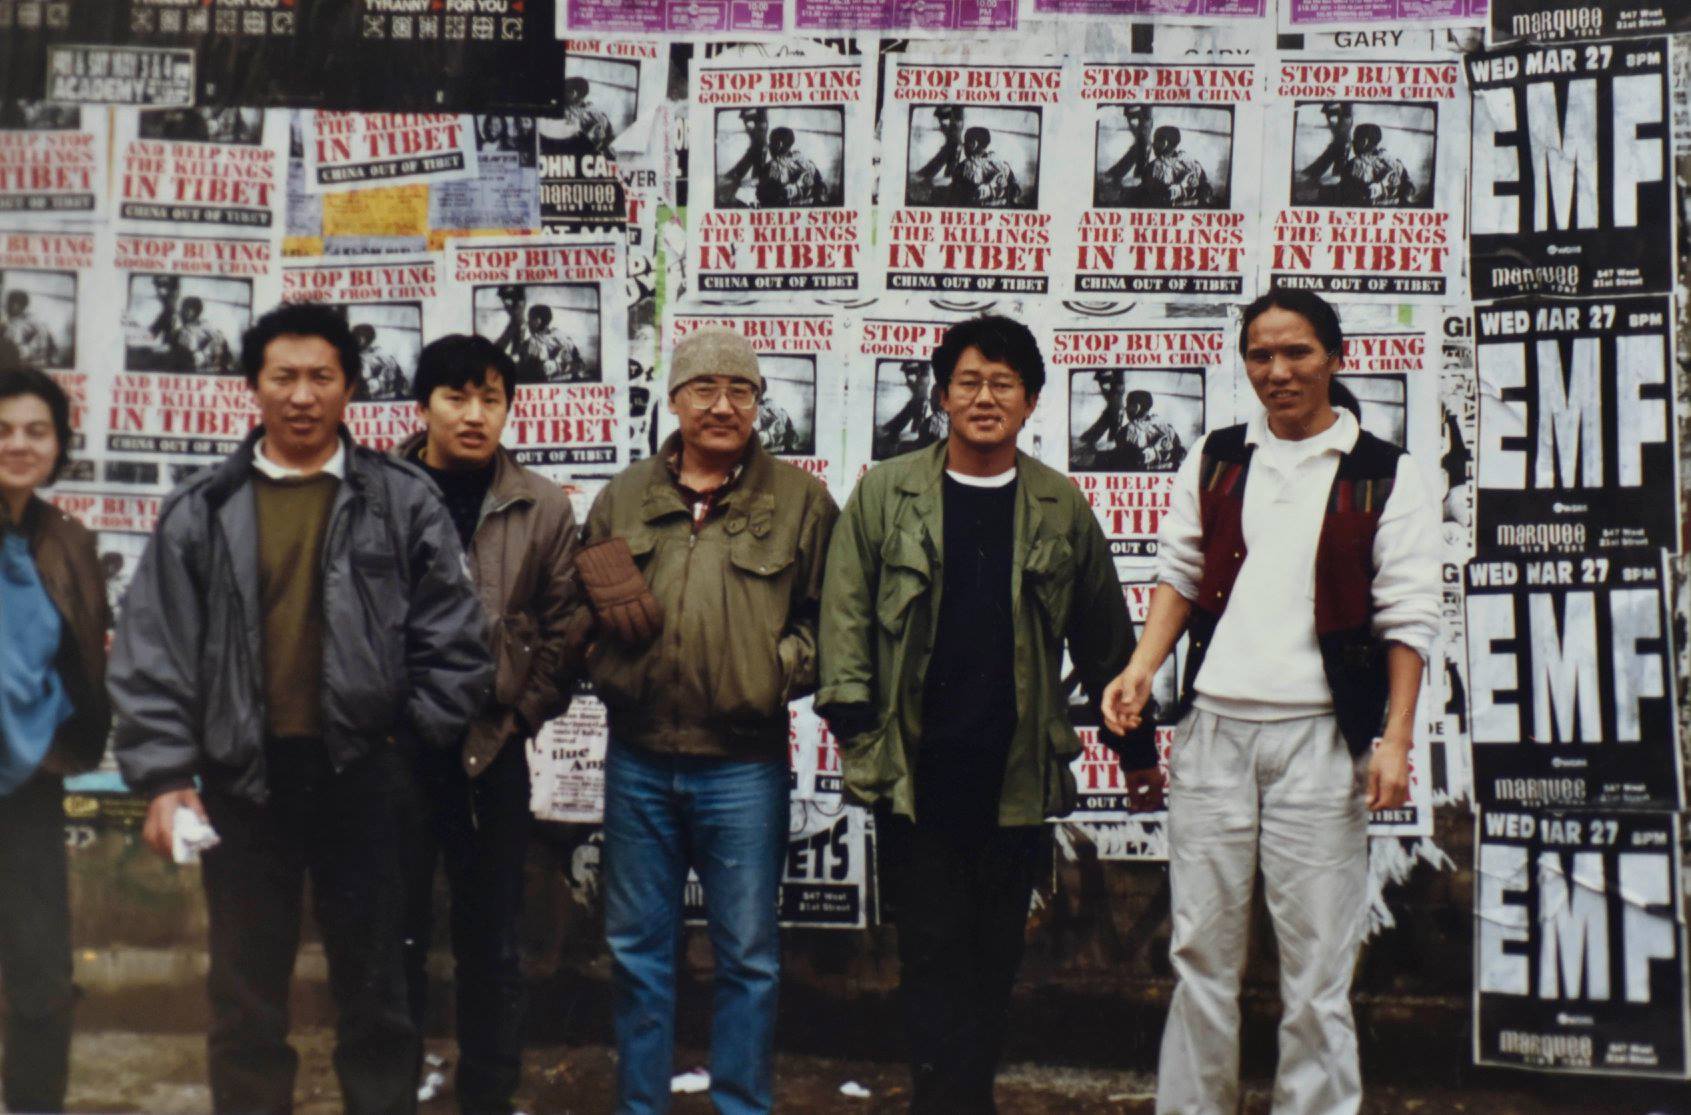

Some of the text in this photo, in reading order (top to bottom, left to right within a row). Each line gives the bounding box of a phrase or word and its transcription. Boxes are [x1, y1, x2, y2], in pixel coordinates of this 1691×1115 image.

[1335, 31, 1402, 48] GARY
[607, 44, 657, 57] CHINA
[1471, 46, 1660, 83] WED MAR 27 8PM
[700, 70, 861, 90] STOP BUYING
[896, 69, 1061, 89] STOP BUYING
[1084, 68, 1253, 87] STOP BUYING
[1281, 66, 1457, 85] STOP BUYING
[699, 89, 860, 103] GOODS FROM CHINA
[894, 88, 1059, 103] GOODS FROM CHINA
[1081, 88, 1251, 101] GOODS FROM CHINA
[1279, 85, 1455, 98] GOODS FROM CHINA
[314, 113, 458, 136] THE KILLINGS
[316, 125, 464, 163] IN TIBET
[1470, 73, 1663, 235] EMF
[126, 157, 165, 172] THE
[322, 168, 364, 181] CHINA
[371, 165, 397, 177] OUT
[402, 162, 417, 174] OF
[123, 175, 275, 206] IN TIBET
[701, 210, 858, 225] AND HELP STOP
[891, 211, 1051, 227] AND HELP STOP
[1079, 212, 1245, 227] AND HELP STOP
[1278, 211, 1320, 225] AND
[1392, 212, 1449, 226] STOP
[699, 227, 858, 242] THE KILLINGS
[890, 226, 1050, 244] THE KILLINGS
[1078, 227, 1244, 244] THE KILLINGS
[1274, 226, 1447, 244] THE KILLINGS
[117, 239, 270, 261] STOP BUYING
[457, 249, 615, 268] STOP BUYING
[700, 244, 860, 270] IN TIBET
[889, 244, 1051, 271] IN TIBET
[1077, 245, 1246, 272] IN TIBET
[1272, 245, 1449, 272] IN TIBET
[283, 268, 436, 287] STOP BUYING
[455, 268, 614, 281] GOODS FROM CHINA
[705, 274, 854, 288] CHINA OUT OF TIBET
[892, 276, 1044, 290] CHINA OUT OF TIBET
[1081, 278, 1238, 292] CHINA OUT OF TIBET
[1277, 277, 1441, 291] CHINA OUT OF TIBET
[340, 287, 436, 299] FROM CHINA
[744, 319, 833, 336] BUYING
[1480, 305, 1663, 336] WED MAR 27 8PM
[863, 324, 926, 343] STOP
[1054, 333, 1223, 351] STOP BUYING
[782, 339, 831, 350] CHINA
[861, 344, 913, 355] GOODS
[1343, 338, 1425, 356] UYING
[1052, 352, 1222, 365] GOODS FROM CHINA
[1369, 357, 1423, 370] CHINA
[567, 386, 615, 400] STOP
[109, 407, 145, 430] IN
[514, 403, 615, 417] KILLINGS
[1477, 335, 1667, 489] EMF
[511, 419, 617, 444] TIBET
[517, 450, 612, 463] OUT OF TIBET
[1106, 476, 1159, 489] HELP
[1110, 543, 1141, 554] OUT
[1470, 562, 1518, 586] WED
[1582, 559, 1609, 583] 27
[1466, 589, 1664, 743] EMF
[1087, 797, 1117, 808] OUT
[1485, 812, 1536, 838] WED
[1590, 820, 1619, 845] 27
[1480, 844, 1675, 1003] EMF
